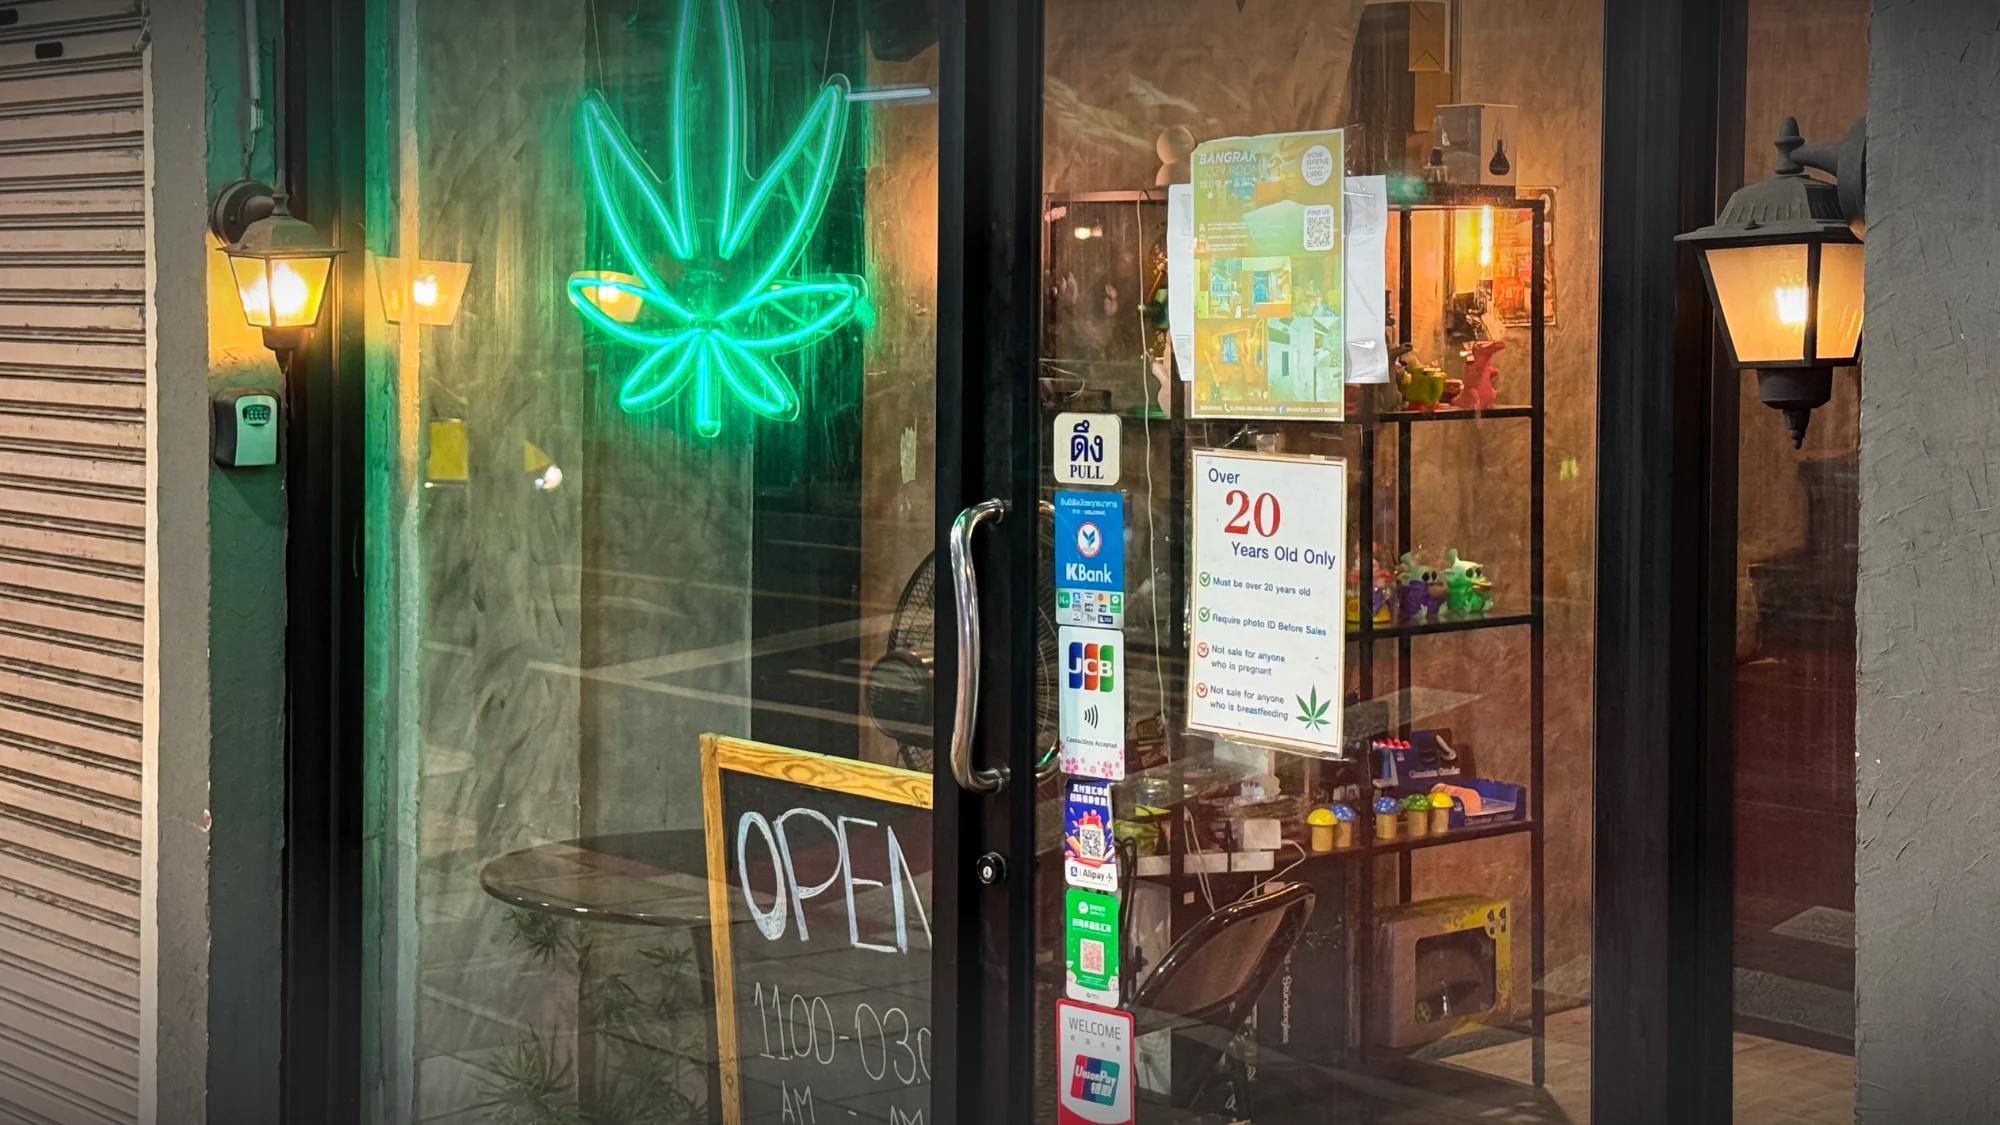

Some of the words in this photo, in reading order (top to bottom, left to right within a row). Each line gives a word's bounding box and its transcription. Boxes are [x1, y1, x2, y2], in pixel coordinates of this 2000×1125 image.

[1200, 150, 1256, 164] BANGRAK
[1070, 419, 1104, 463] ดึง
[1070, 464, 1104, 480] PULL
[1208, 468, 1240, 484] Over
[1224, 490, 1281, 538] 20
[1231, 541, 1270, 560] Years
[1274, 546, 1298, 562] Old
[1304, 549, 1336, 570] Only
[1066, 562, 1112, 584] KBank
[1212, 577, 1232, 586] Must
[1234, 579, 1243, 588] be
[1246, 582, 1262, 590] over
[1264, 583, 1274, 592] 20
[1276, 585, 1296, 595] years
[1298, 587, 1311, 597] old
[1212, 613, 1241, 626] Require
[1243, 618, 1265, 628] photo
[1268, 620, 1276, 630] ID
[1278, 622, 1303, 634] Before
[1306, 626, 1327, 636] Sales
[1212, 644, 1225, 654] Not
[1228, 647, 1243, 656] sale
[1244, 649, 1256, 658] for
[1258, 653, 1286, 663] anyone
[1069, 657, 1113, 677] JCB
[1211, 660, 1227, 669] who
[1229, 662, 1236, 670] is
[1238, 664, 1272, 676] pregnant
[1210, 685, 1224, 694] Not
[1226, 688, 1242, 697] sale
[1244, 690, 1254, 699] for
[1256, 694, 1284, 704] anyone
[1210, 700, 1226, 710] who
[1228, 702, 1234, 711] is
[1236, 704, 1289, 720] breastfeeding
[1066, 736, 1094, 746] Contactless
[1094, 739, 1118, 748] Accepted
[1068, 1017, 1121, 1040] WELCOME
[1075, 1064, 1116, 1088] UnionPay
[782, 1080, 816, 1125] AM
